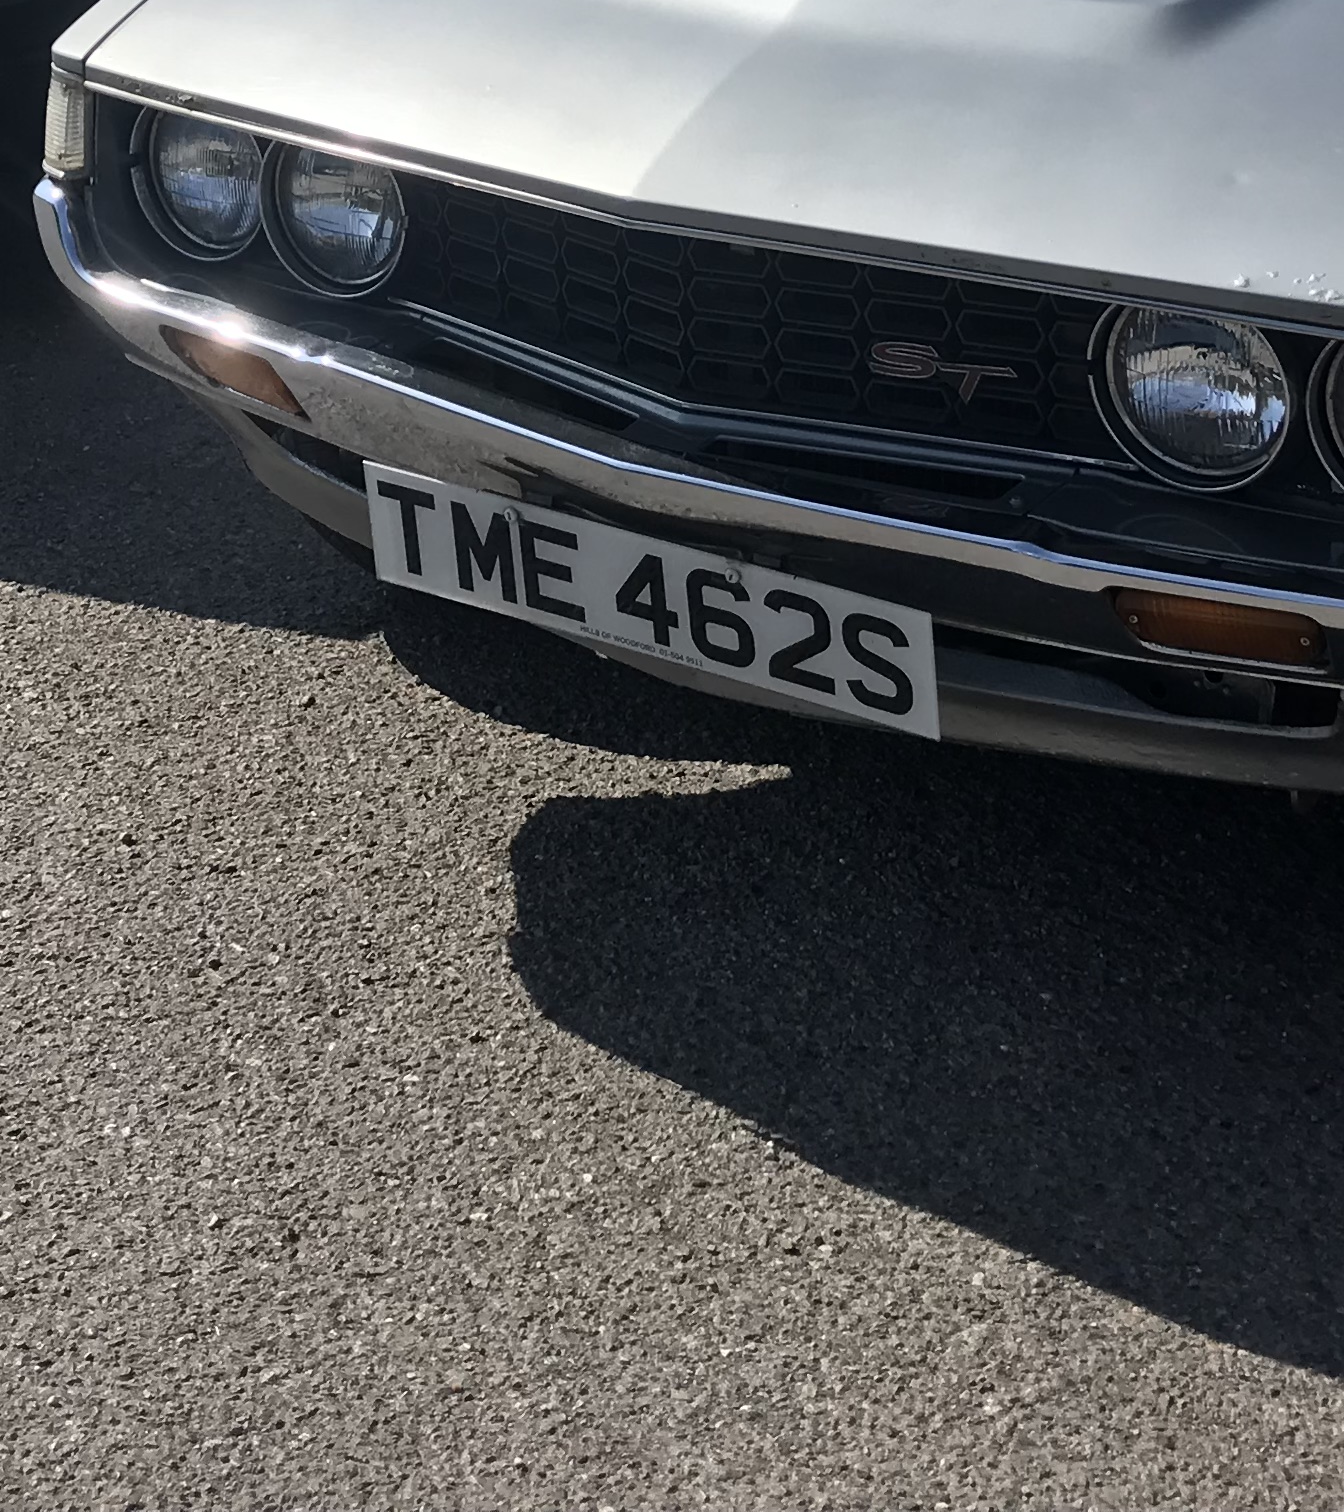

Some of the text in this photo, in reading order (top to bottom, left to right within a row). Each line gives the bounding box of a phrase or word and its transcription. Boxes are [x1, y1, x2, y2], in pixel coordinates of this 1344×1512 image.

[867, 341, 1019, 405] ST
[376, 479, 915, 717] TME 462S
[579, 624, 600, 637] HILLS
[601, 630, 612, 640] OF
[613, 634, 656, 654] WOODFORD
